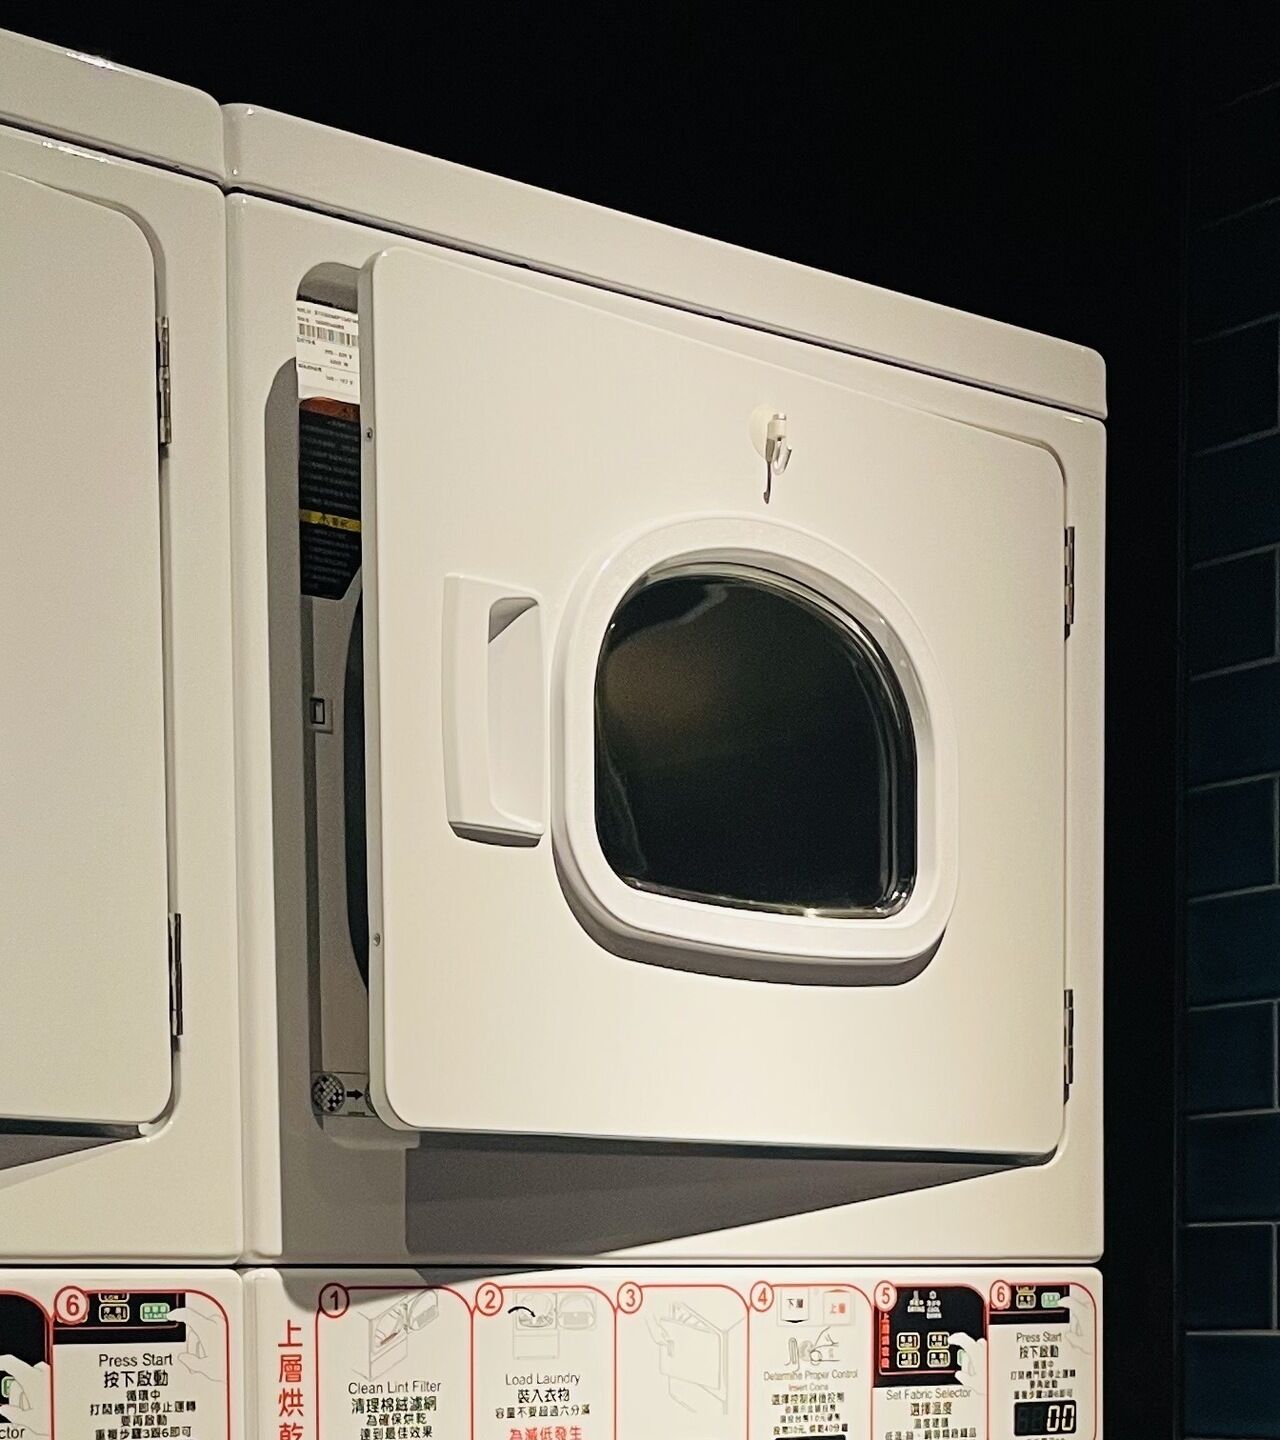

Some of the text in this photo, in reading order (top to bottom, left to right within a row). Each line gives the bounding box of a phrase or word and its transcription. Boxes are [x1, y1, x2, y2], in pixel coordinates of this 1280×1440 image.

[1016, 1333, 1062, 1343] Press Start
[98, 1352, 173, 1368] Press Start
[103, 1370, 169, 1388] 按下啟動
[506, 1372, 580, 1386] Load Laundry
[348, 1381, 441, 1394] Clean Lint Filter
